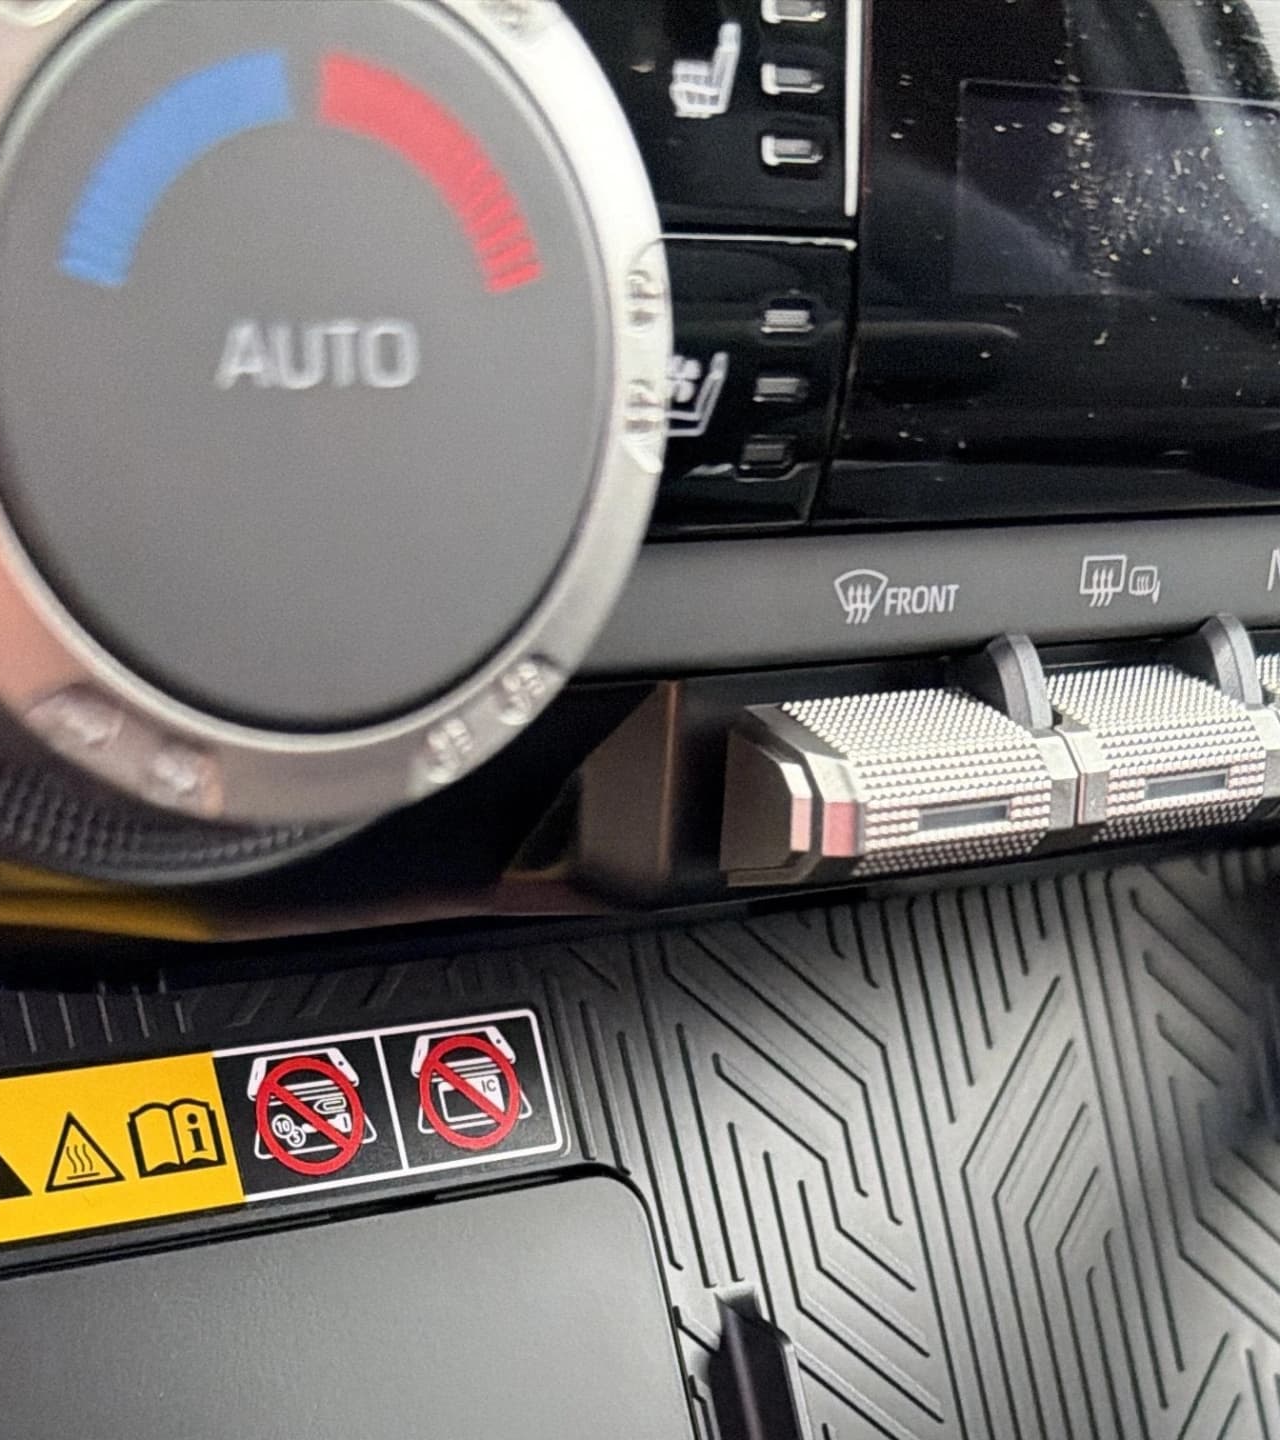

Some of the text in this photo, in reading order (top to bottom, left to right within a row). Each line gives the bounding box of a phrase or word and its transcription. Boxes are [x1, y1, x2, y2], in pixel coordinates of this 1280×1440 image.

[216, 319, 419, 390] AUTO
[884, 584, 960, 616] FRONT
[481, 1078, 497, 1093] IC
[276, 1120, 291, 1134] 10
[292, 1131, 301, 1144] 5
